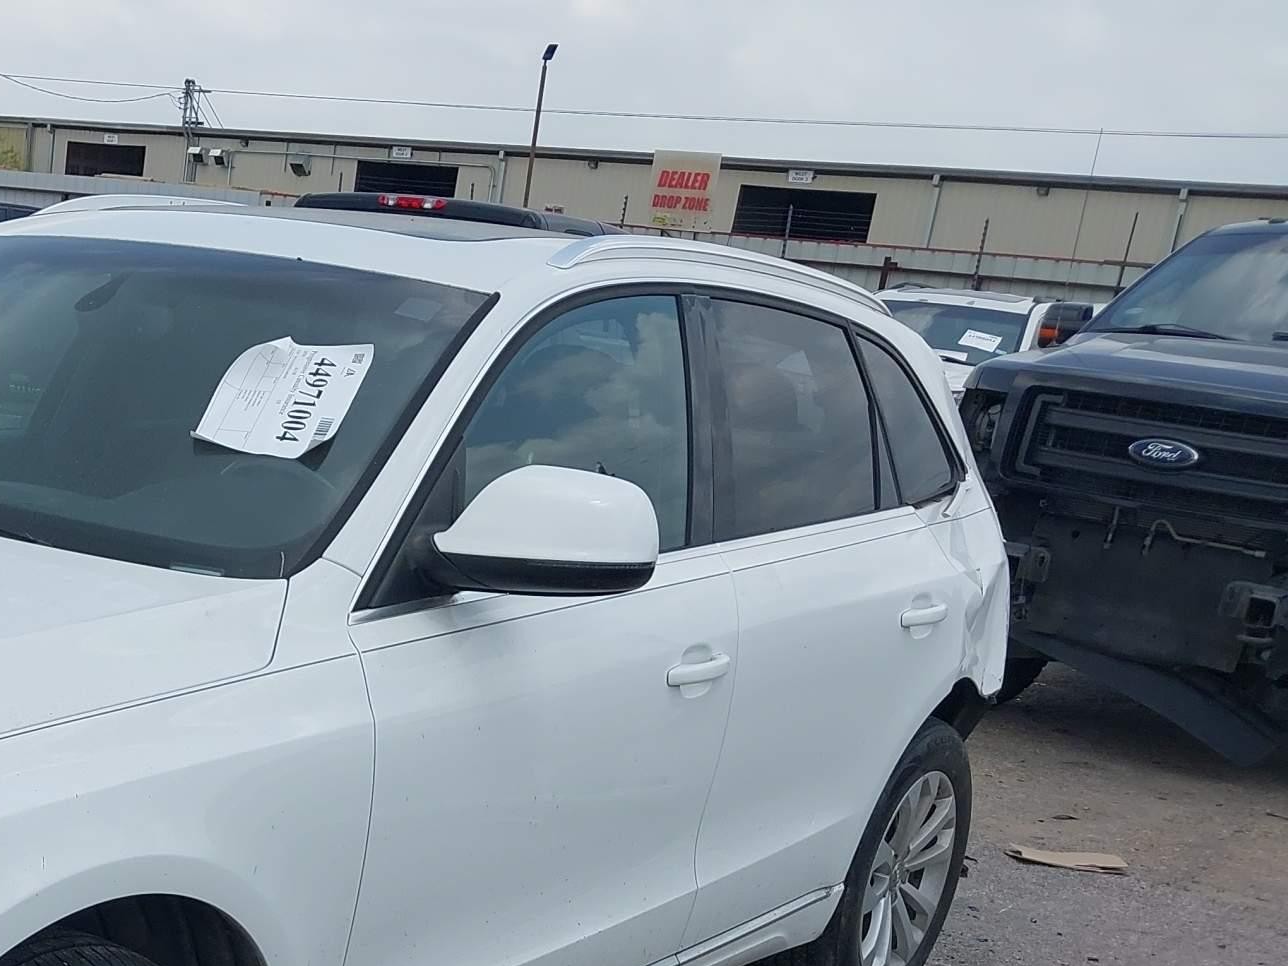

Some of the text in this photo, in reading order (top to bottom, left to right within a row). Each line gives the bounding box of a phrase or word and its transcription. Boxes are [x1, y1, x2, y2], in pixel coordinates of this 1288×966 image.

[657, 170, 711, 191] DEALER
[652, 194, 711, 212] DROP ZONE
[275, 357, 337, 442] 44971004
[1142, 442, 1182, 461] Ford
